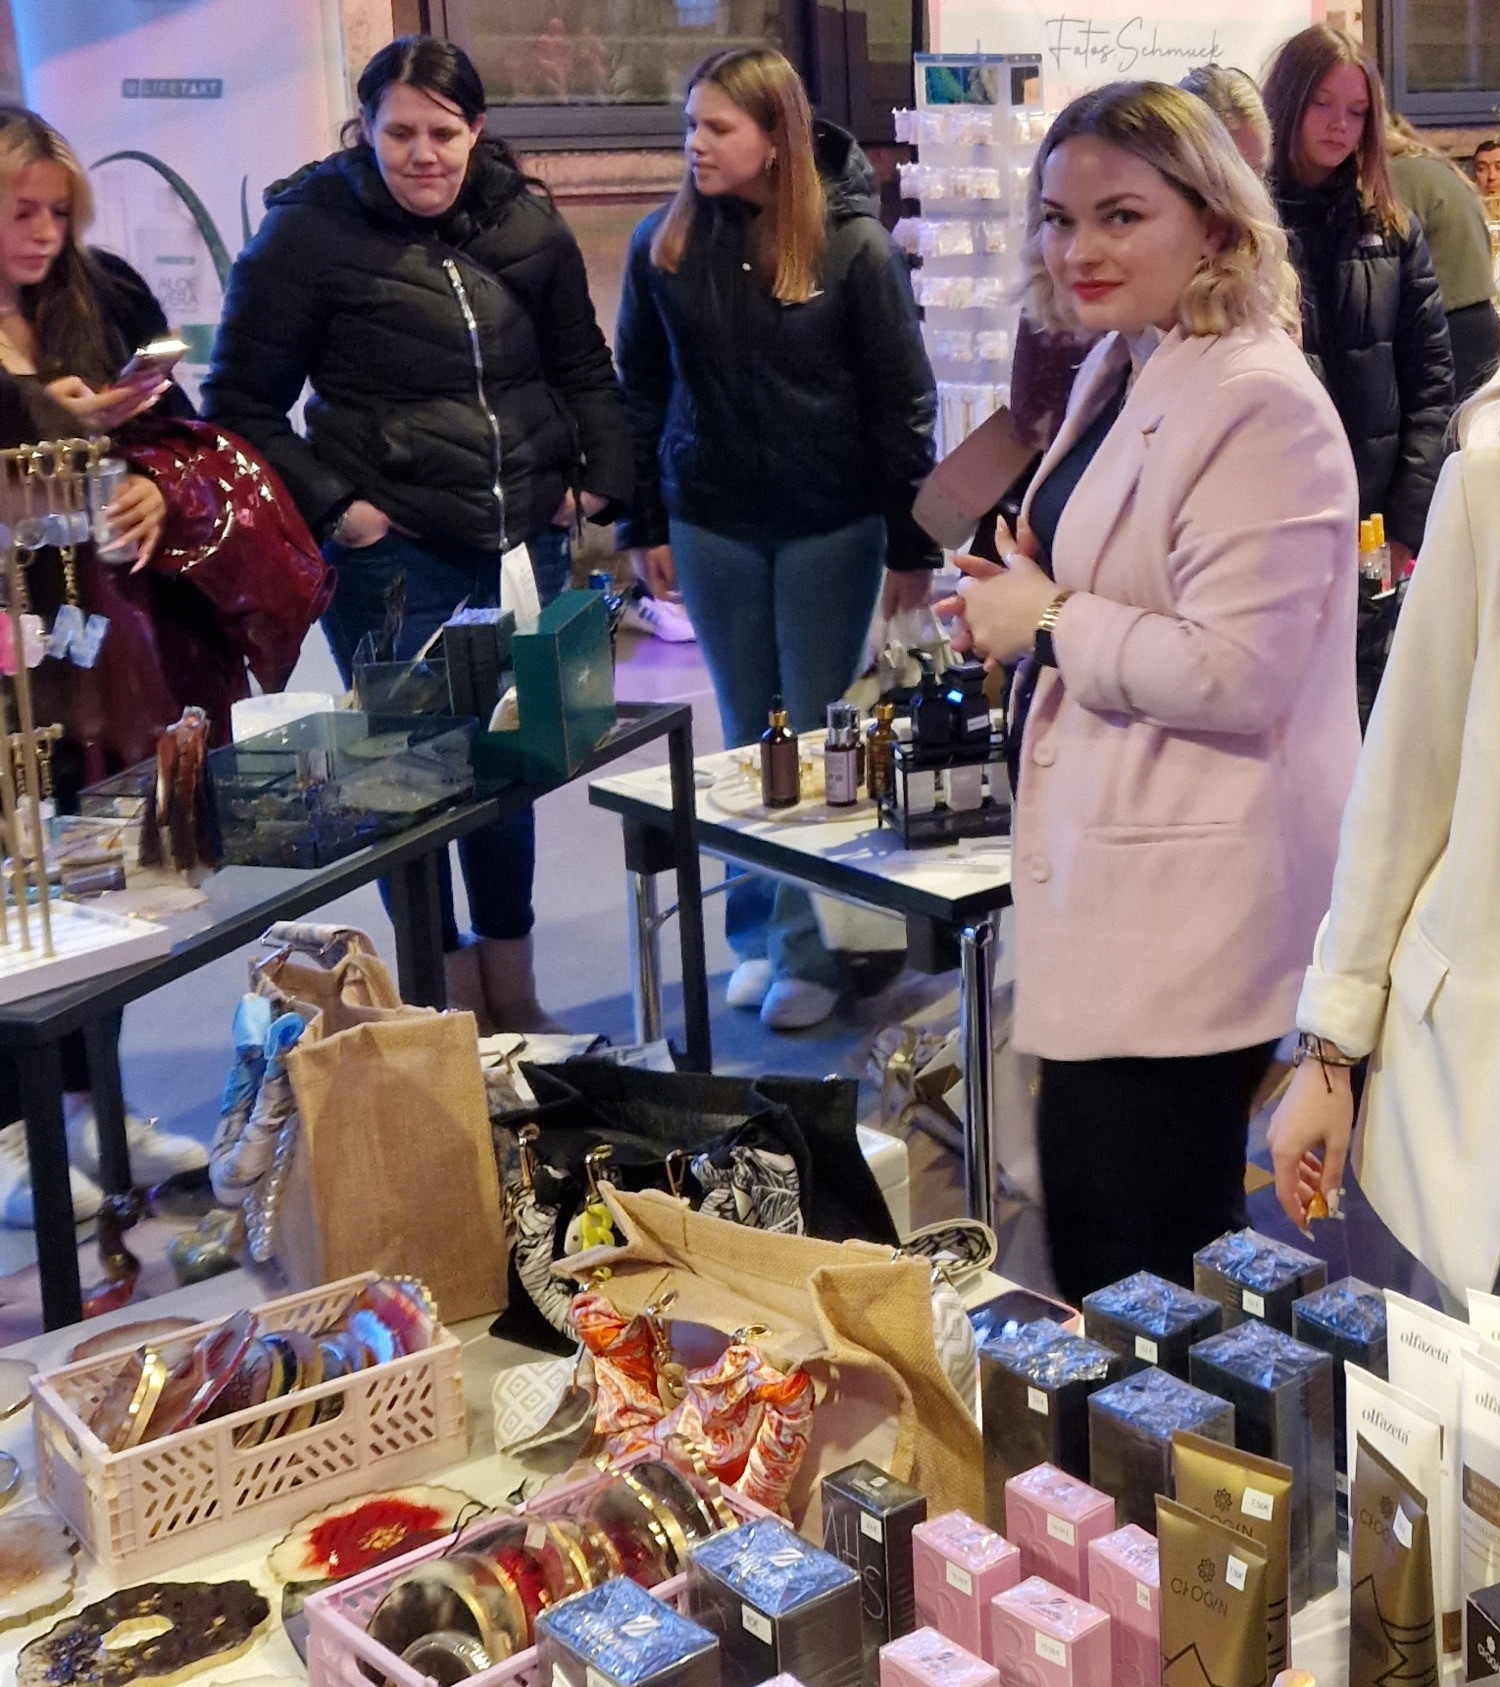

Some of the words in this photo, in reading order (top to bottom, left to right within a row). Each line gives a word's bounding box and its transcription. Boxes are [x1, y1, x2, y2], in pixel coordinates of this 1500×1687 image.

[1400, 1331, 1449, 1365] olfazeta
[1361, 1407, 1410, 1446] olfazeta
[1170, 1577, 1229, 1617] CHOGAN
